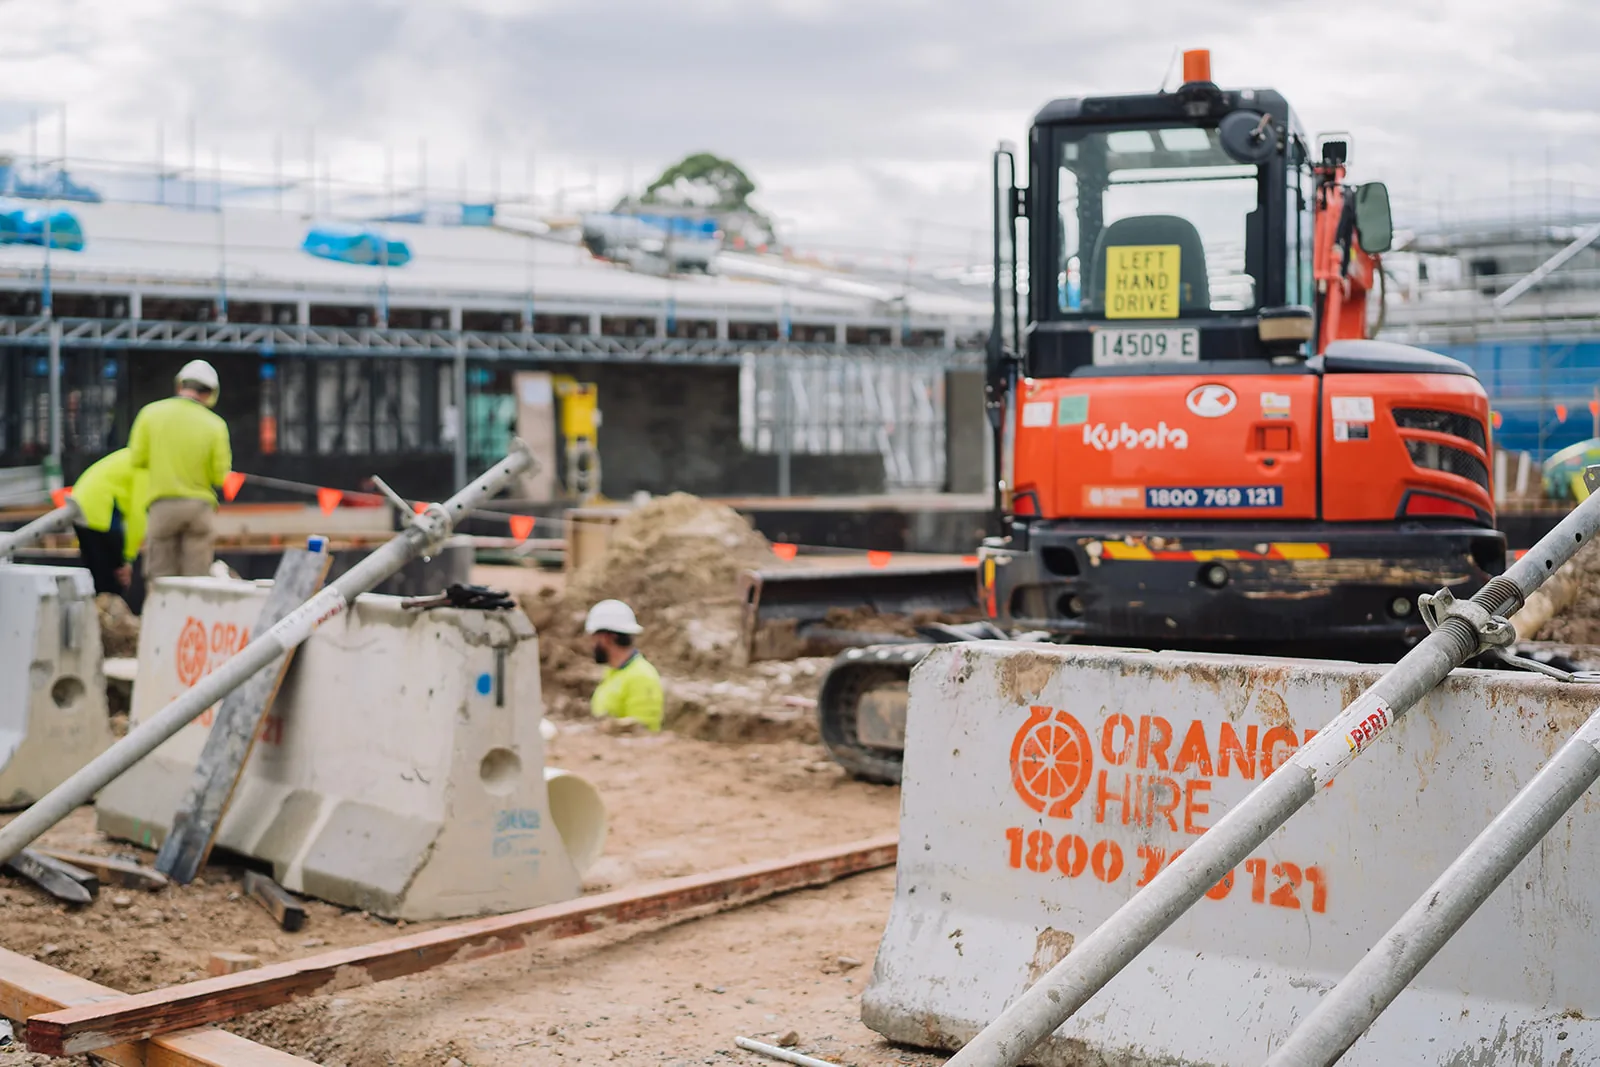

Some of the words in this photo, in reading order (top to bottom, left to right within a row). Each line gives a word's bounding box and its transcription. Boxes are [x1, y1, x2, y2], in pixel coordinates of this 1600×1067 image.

[1119, 251, 1166, 270] LEFT
[1116, 273, 1169, 291] HAND
[1113, 293, 1169, 312] DRIVE
[1102, 333, 1168, 356] 14509
[1181, 332, 1194, 356] E
[1083, 421, 1188, 450] Kubota
[1149, 488, 1199, 507] 1800
[1203, 488, 1242, 507] 769
[1246, 487, 1276, 506] 121
[1101, 712, 1335, 789] ORANG
[1096, 769, 1212, 835] HIRE
[1005, 826, 1124, 884] 1800
[1245, 857, 1328, 914] 121
